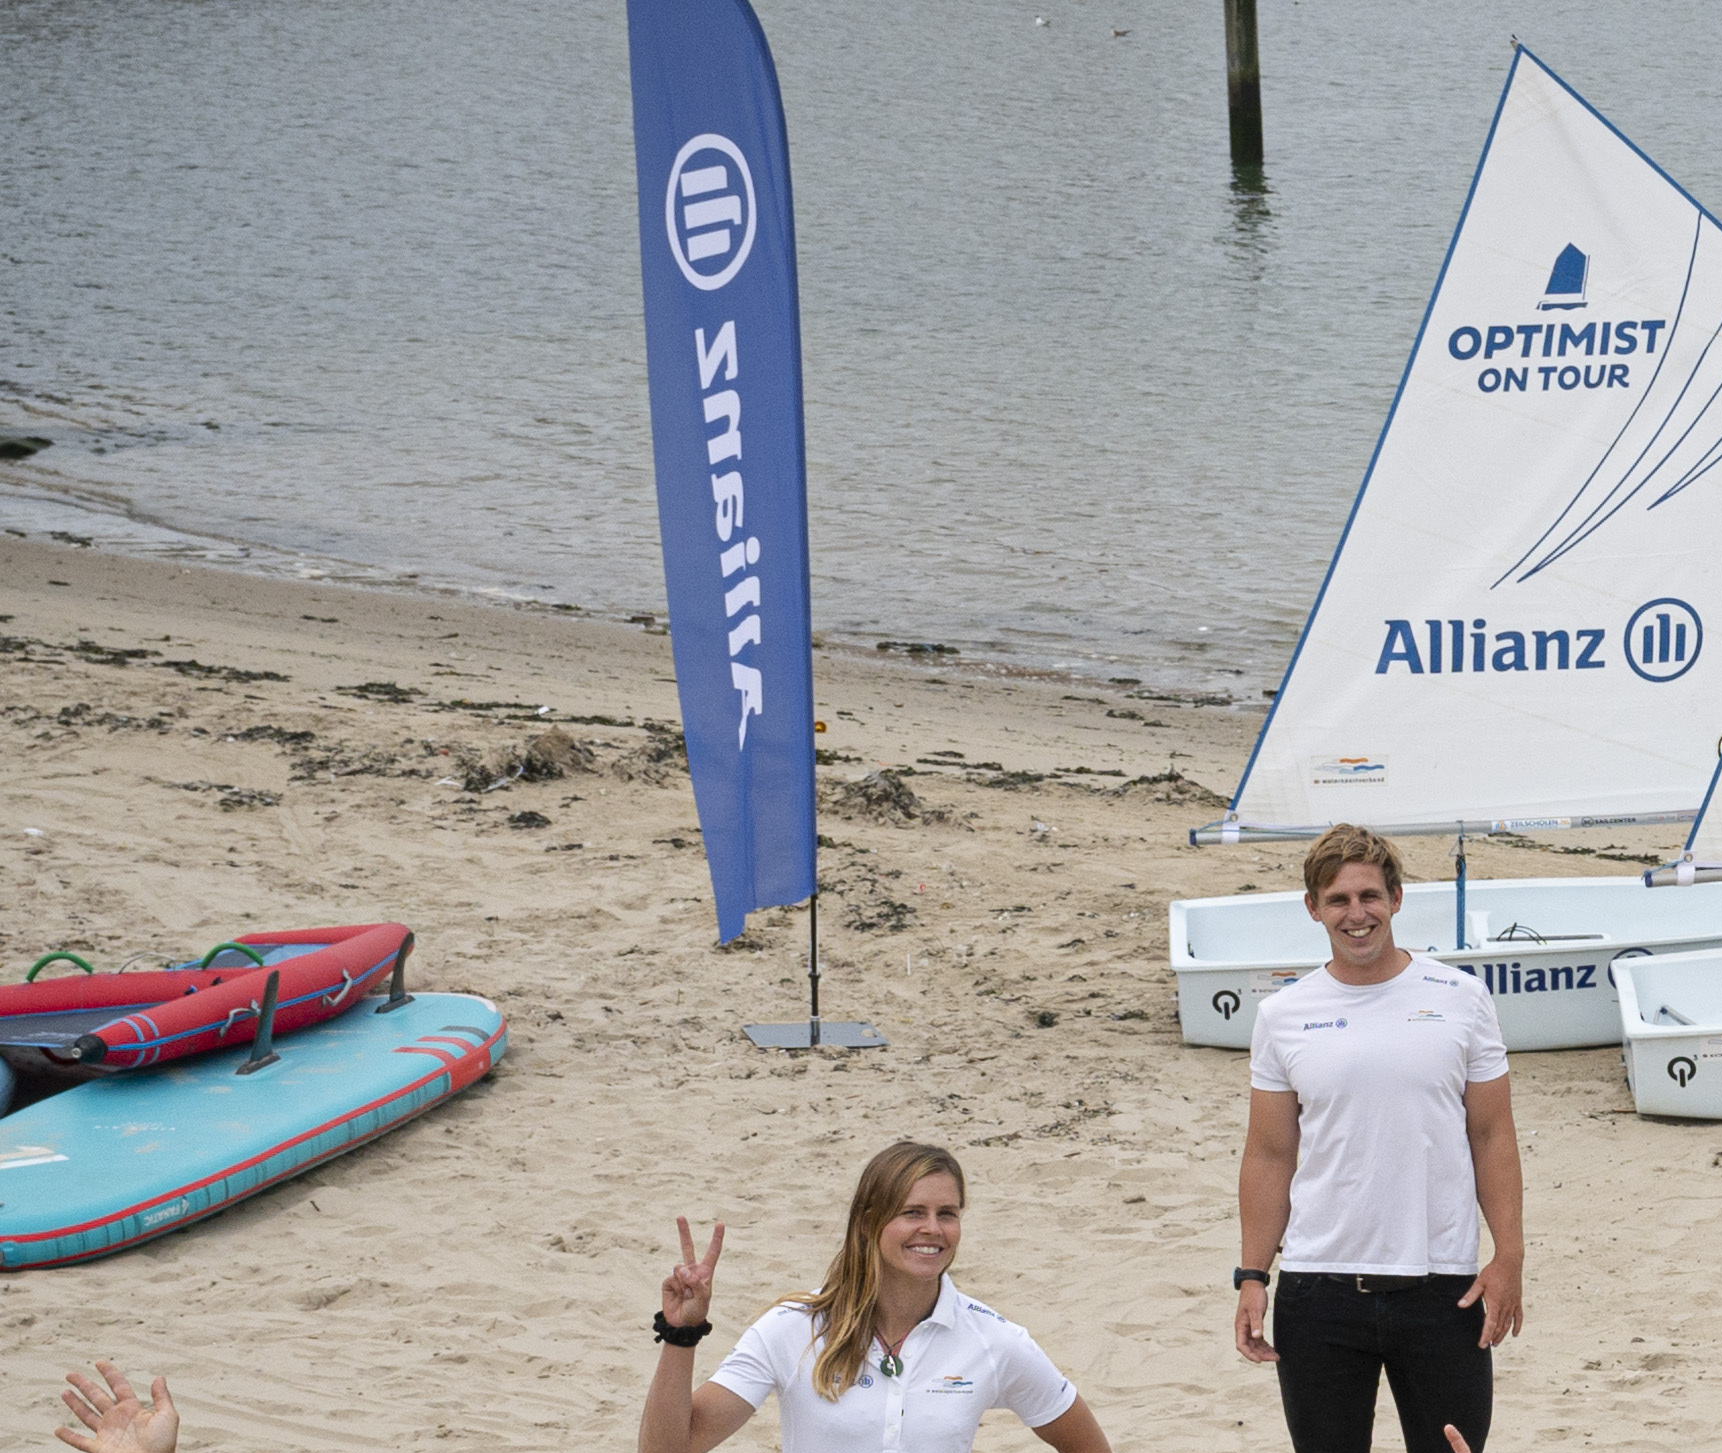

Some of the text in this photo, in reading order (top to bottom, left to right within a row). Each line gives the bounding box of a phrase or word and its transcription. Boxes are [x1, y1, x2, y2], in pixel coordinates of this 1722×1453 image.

[1448, 320, 1666, 360] OPTIMIST
[1477, 363, 1630, 394] ON TOUR
[1375, 618, 1606, 675] Allianz
[1303, 1021, 1333, 1031] Allianz
